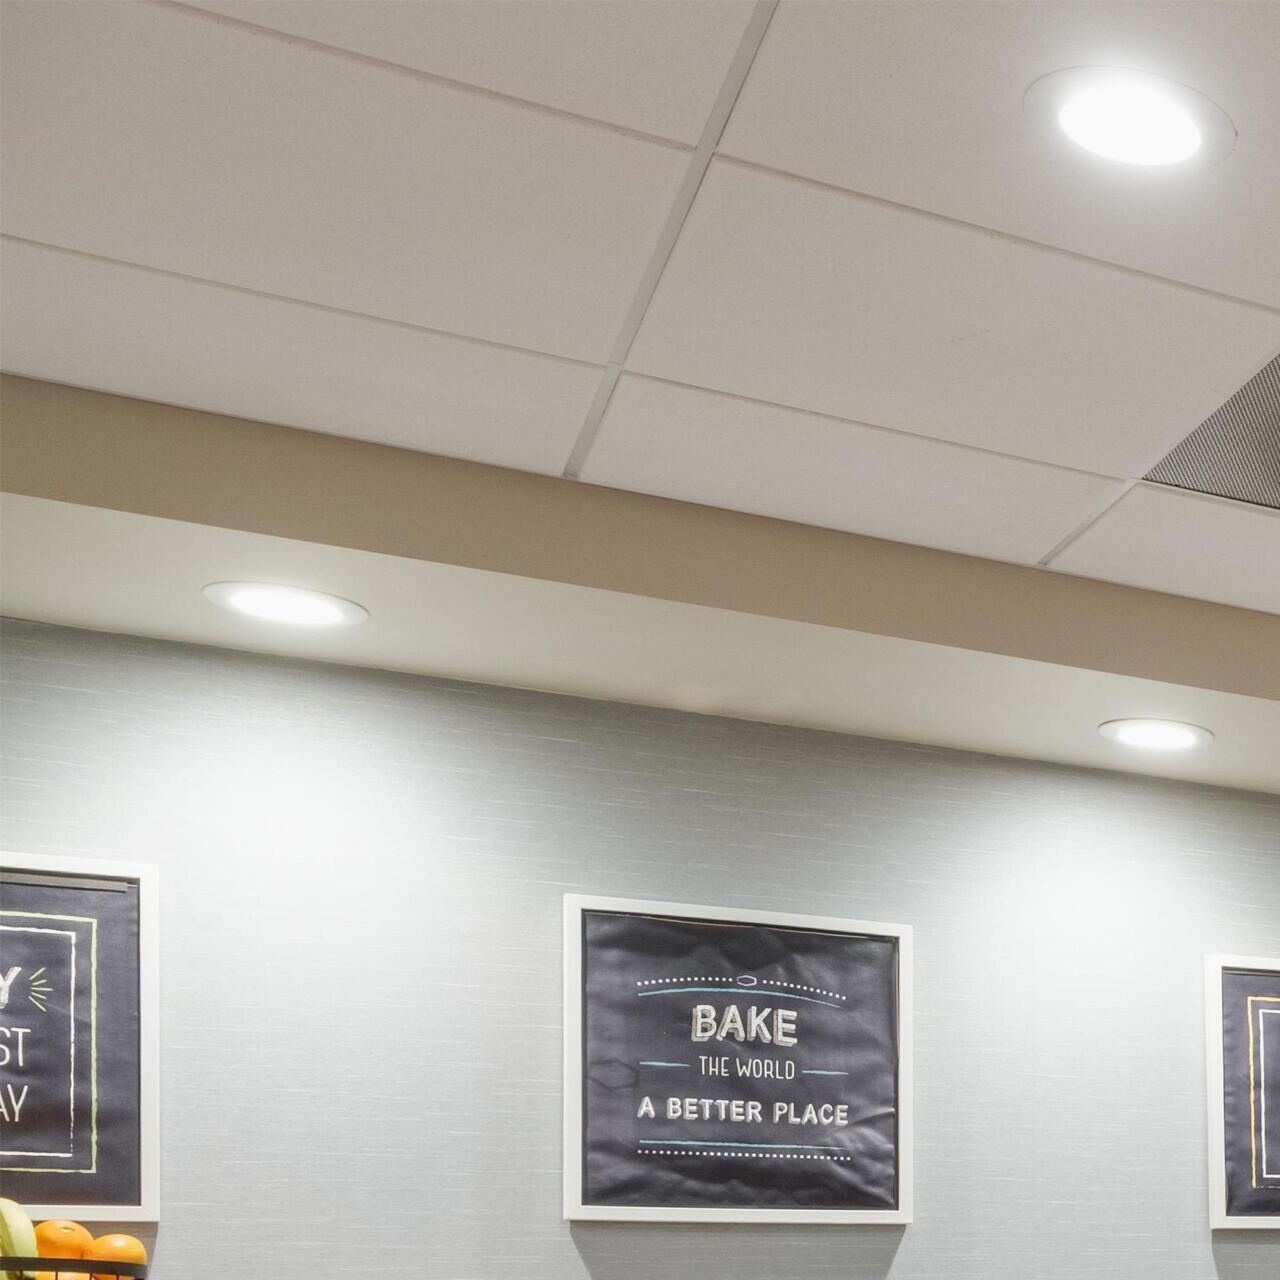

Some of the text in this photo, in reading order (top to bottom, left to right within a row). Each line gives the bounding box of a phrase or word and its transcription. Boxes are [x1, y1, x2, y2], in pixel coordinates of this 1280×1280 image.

[691, 1004, 798, 1046] BAKE
[699, 1056, 795, 1080] THE WORLD
[637, 1096, 849, 1126] A BETTER PLACE
